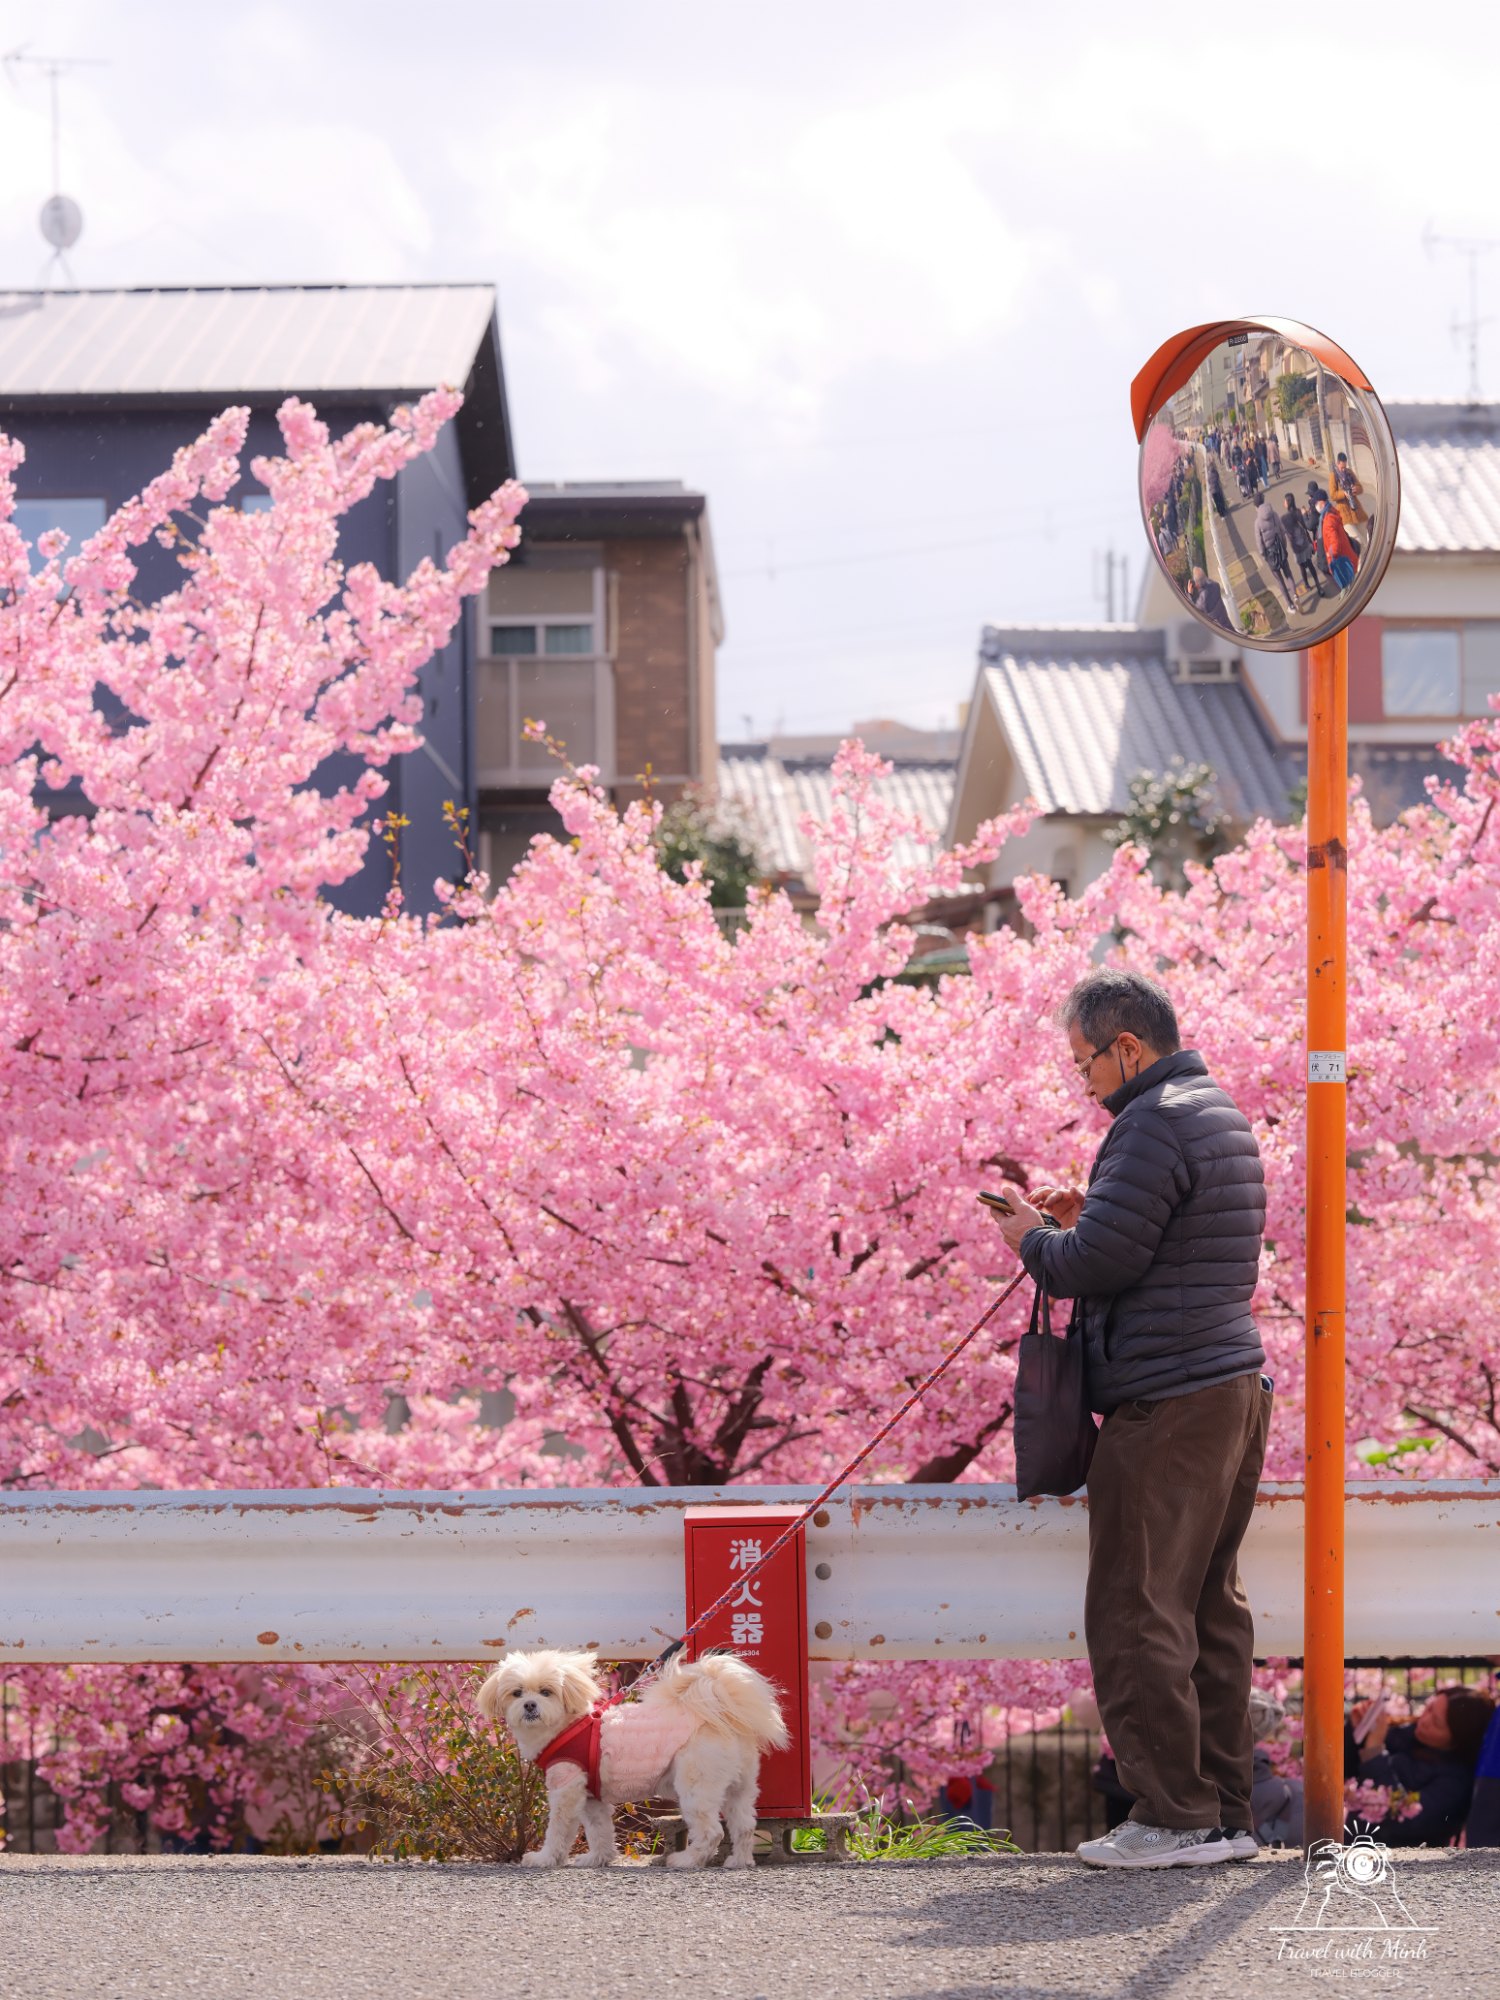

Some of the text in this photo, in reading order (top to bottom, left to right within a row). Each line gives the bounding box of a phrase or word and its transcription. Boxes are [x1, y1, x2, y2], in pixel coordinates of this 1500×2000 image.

[1328, 1063, 1339, 1072] 71
[729, 1538, 764, 1644] 消火器
